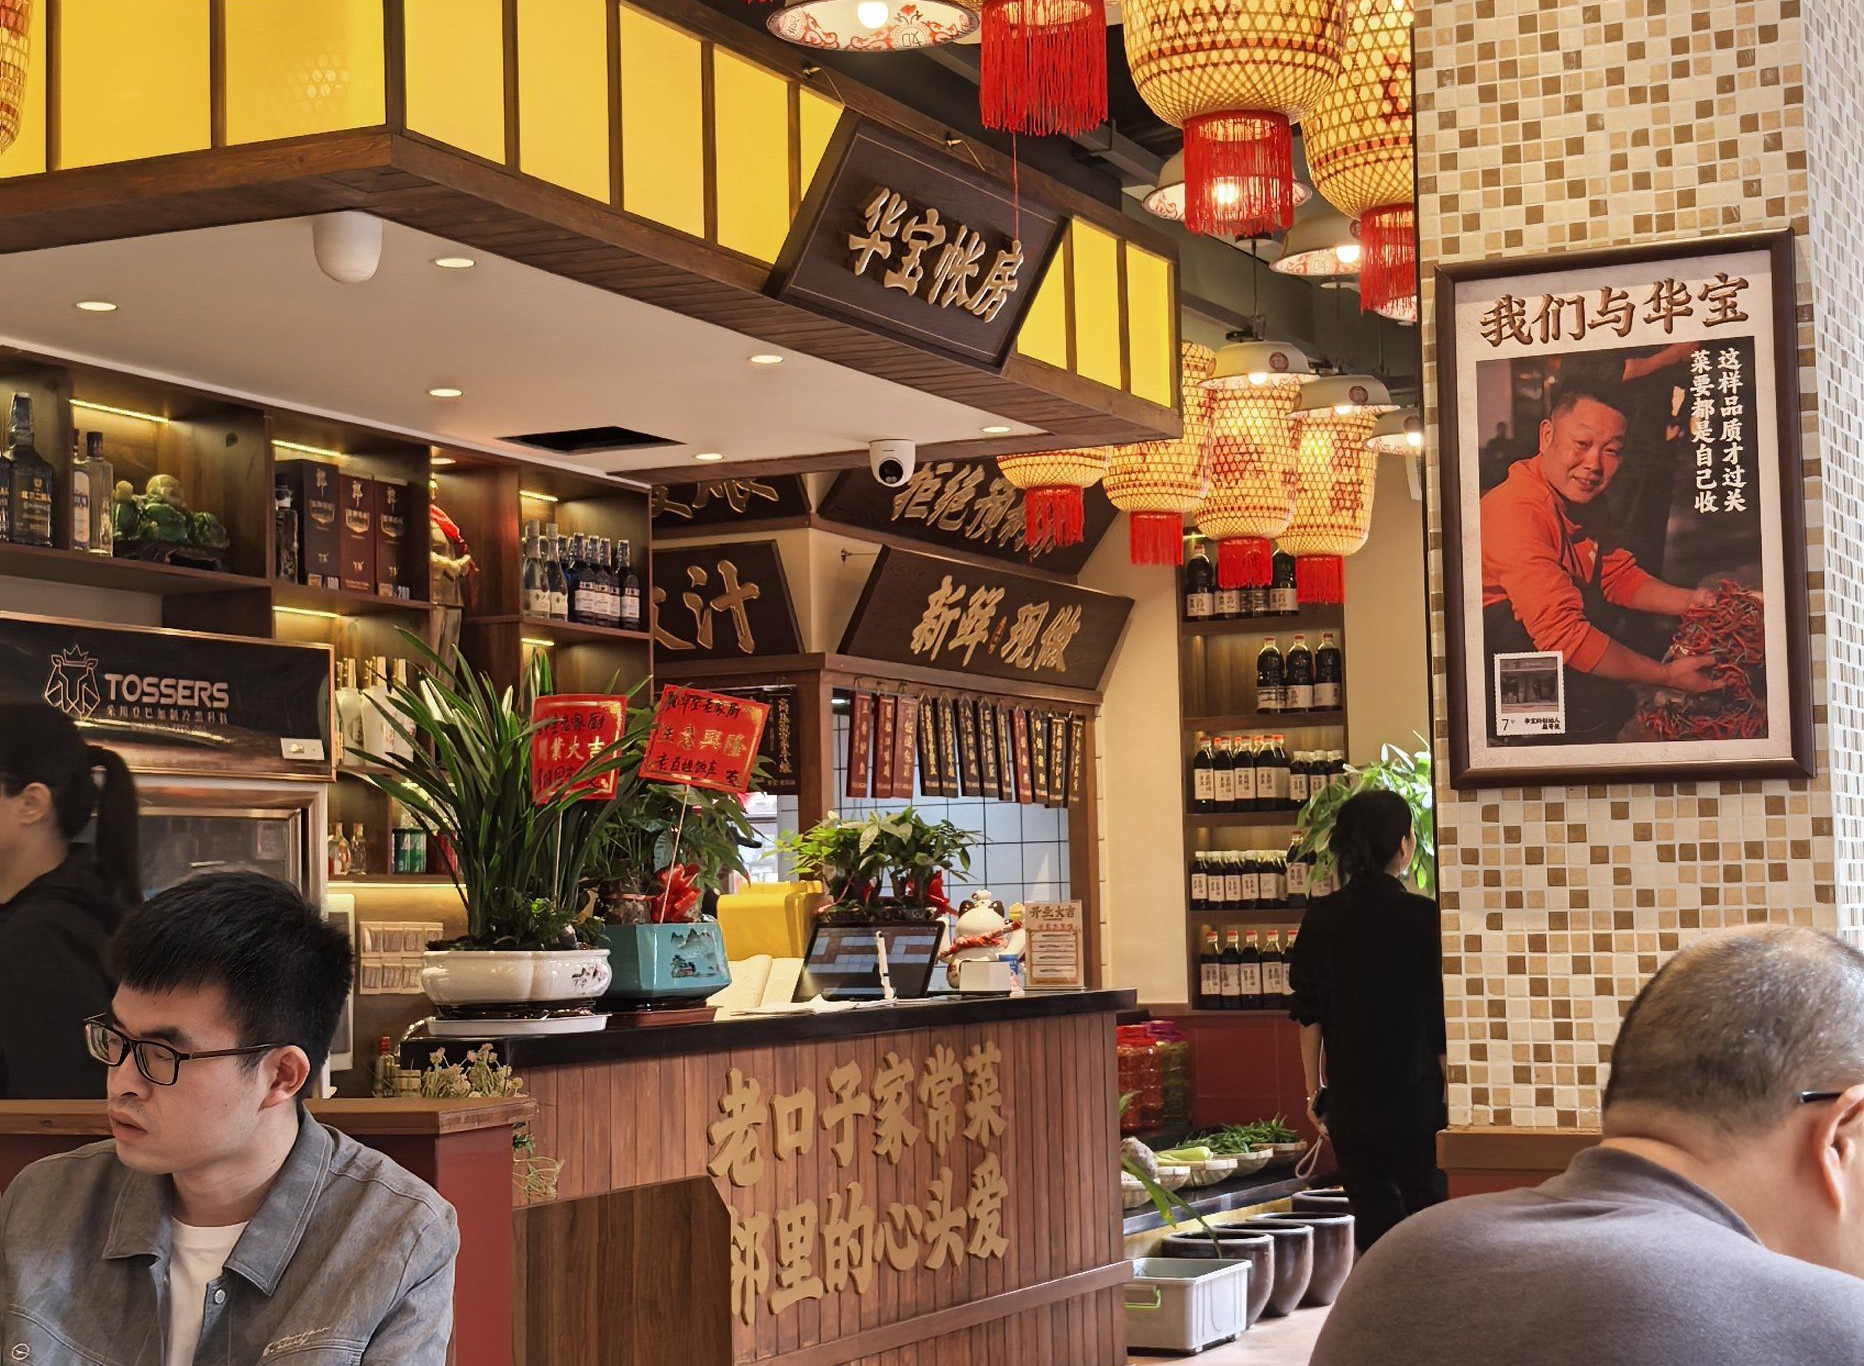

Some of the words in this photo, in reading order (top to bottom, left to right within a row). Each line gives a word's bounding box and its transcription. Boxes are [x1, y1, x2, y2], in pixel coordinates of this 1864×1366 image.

[1480, 271, 1750, 347] 我们与华宝
[1689, 349, 1720, 514] 菜要都是自己收
[1717, 347, 1748, 513] 这样品质才过关
[104, 672, 231, 709] TOSSERS
[1501, 718, 1510, 731] 7
[1029, 905, 1076, 920] 开业大吉
[707, 1040, 1008, 1188] 老口子家常菜
